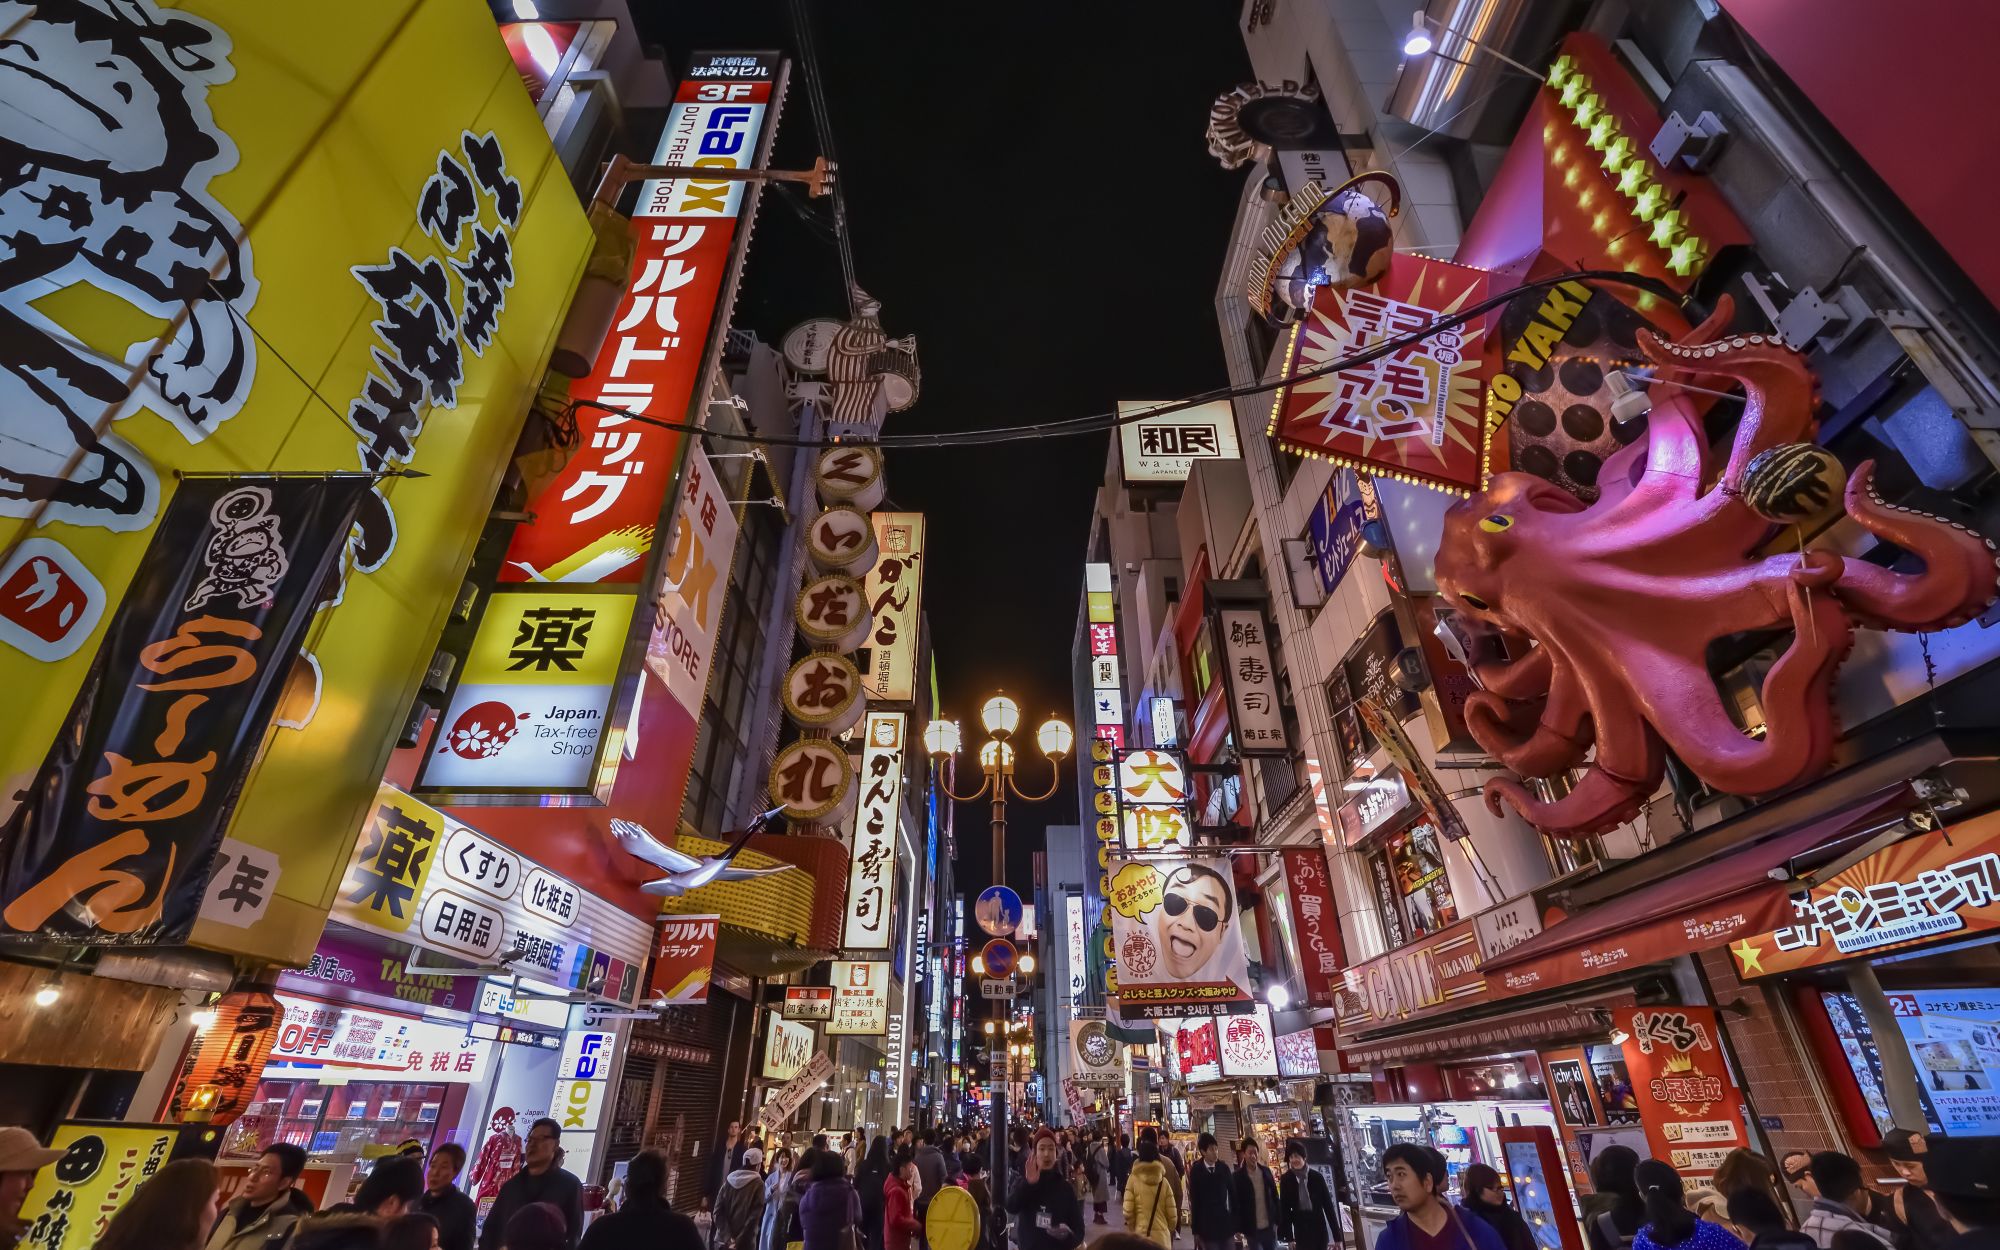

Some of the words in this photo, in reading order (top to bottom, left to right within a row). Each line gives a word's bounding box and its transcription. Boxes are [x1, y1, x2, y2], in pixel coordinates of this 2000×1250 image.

[697, 84, 753, 102] 3F
[677, 106, 700, 135] DUTY
[649, 177, 675, 213] TORE
[1262, 181, 1325, 255] MUSEUM
[1507, 280, 1592, 371] YAKI
[561, 225, 706, 524] ツルハドラッグ
[1143, 427, 1216, 453] 和民
[872, 552, 920, 646] がんこ
[504, 607, 597, 672] 薬
[654, 604, 701, 682] STORE
[876, 650, 891, 694] 道頓堀店
[1099, 662, 1113, 682] 和民
[544, 706, 602, 720] Japan.
[533, 724, 599, 738] Tax-free
[1243, 729, 1283, 741] 菊正宗
[550, 742, 594, 758] Shop
[4, 615, 263, 932] らーめん
[348, 804, 436, 920] 薬
[459, 842, 511, 889] くすり
[534, 876, 574, 919] 化粧品
[1115, 870, 1157, 903] おみやげ
[1776, 854, 2000, 951] コナモンミュージア
[433, 903, 494, 950] 日用品
[663, 922, 716, 941] ツルハ
[1494, 910, 1520, 932] JAZZ
[660, 943, 704, 958] ドラッグ
[914, 915, 928, 984] TSUTAYA
[482, 990, 498, 1008] 3F
[983, 983, 1015, 995] 自動車
[1367, 945, 1445, 1021] GAME
[1889, 996, 1918, 1016] 2F
[280, 1023, 336, 1056] OFF
[886, 1014, 902, 1079] FOREVER
[1647, 1015, 1697, 1050] くくる
[405, 1050, 478, 1073] 免税店
[1072, 1072, 1097, 1080] CAFE
[1650, 1077, 1723, 1102] 3冠達成
